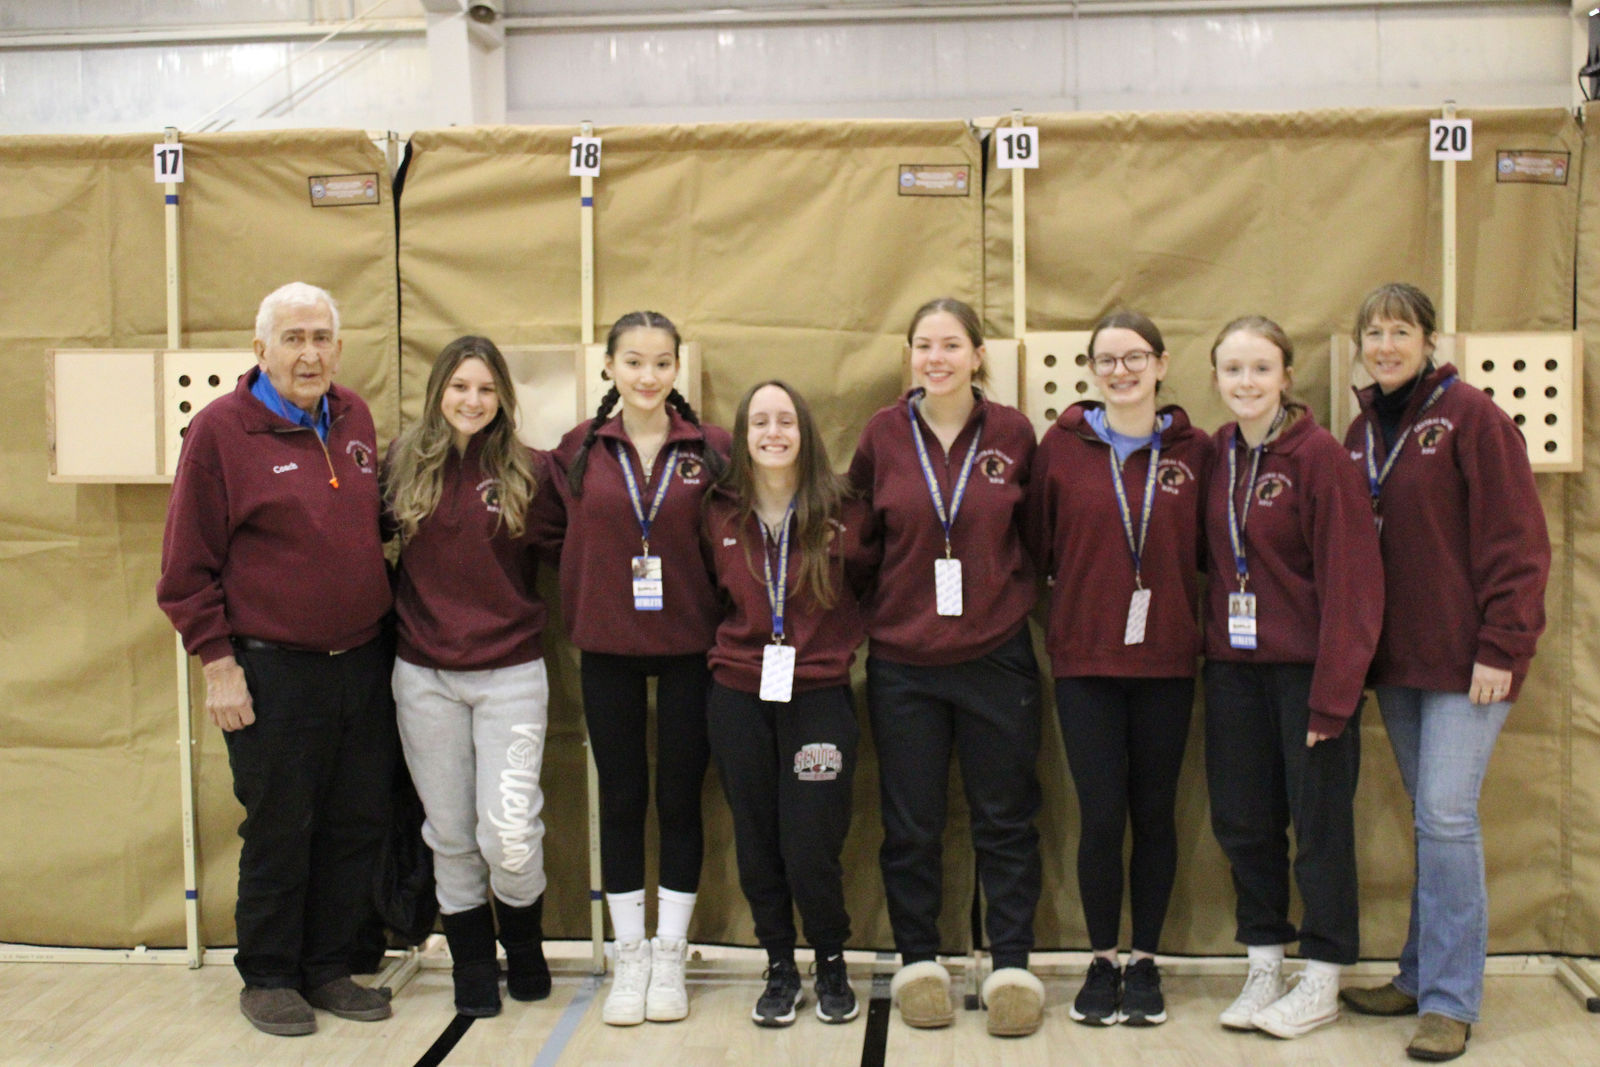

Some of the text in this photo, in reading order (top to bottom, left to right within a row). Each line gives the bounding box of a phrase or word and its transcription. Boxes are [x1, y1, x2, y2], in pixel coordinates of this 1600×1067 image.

[1003, 133, 1032, 160] 19
[1435, 125, 1467, 152] 20
[156, 149, 180, 175] 17
[571, 142, 599, 169] 18
